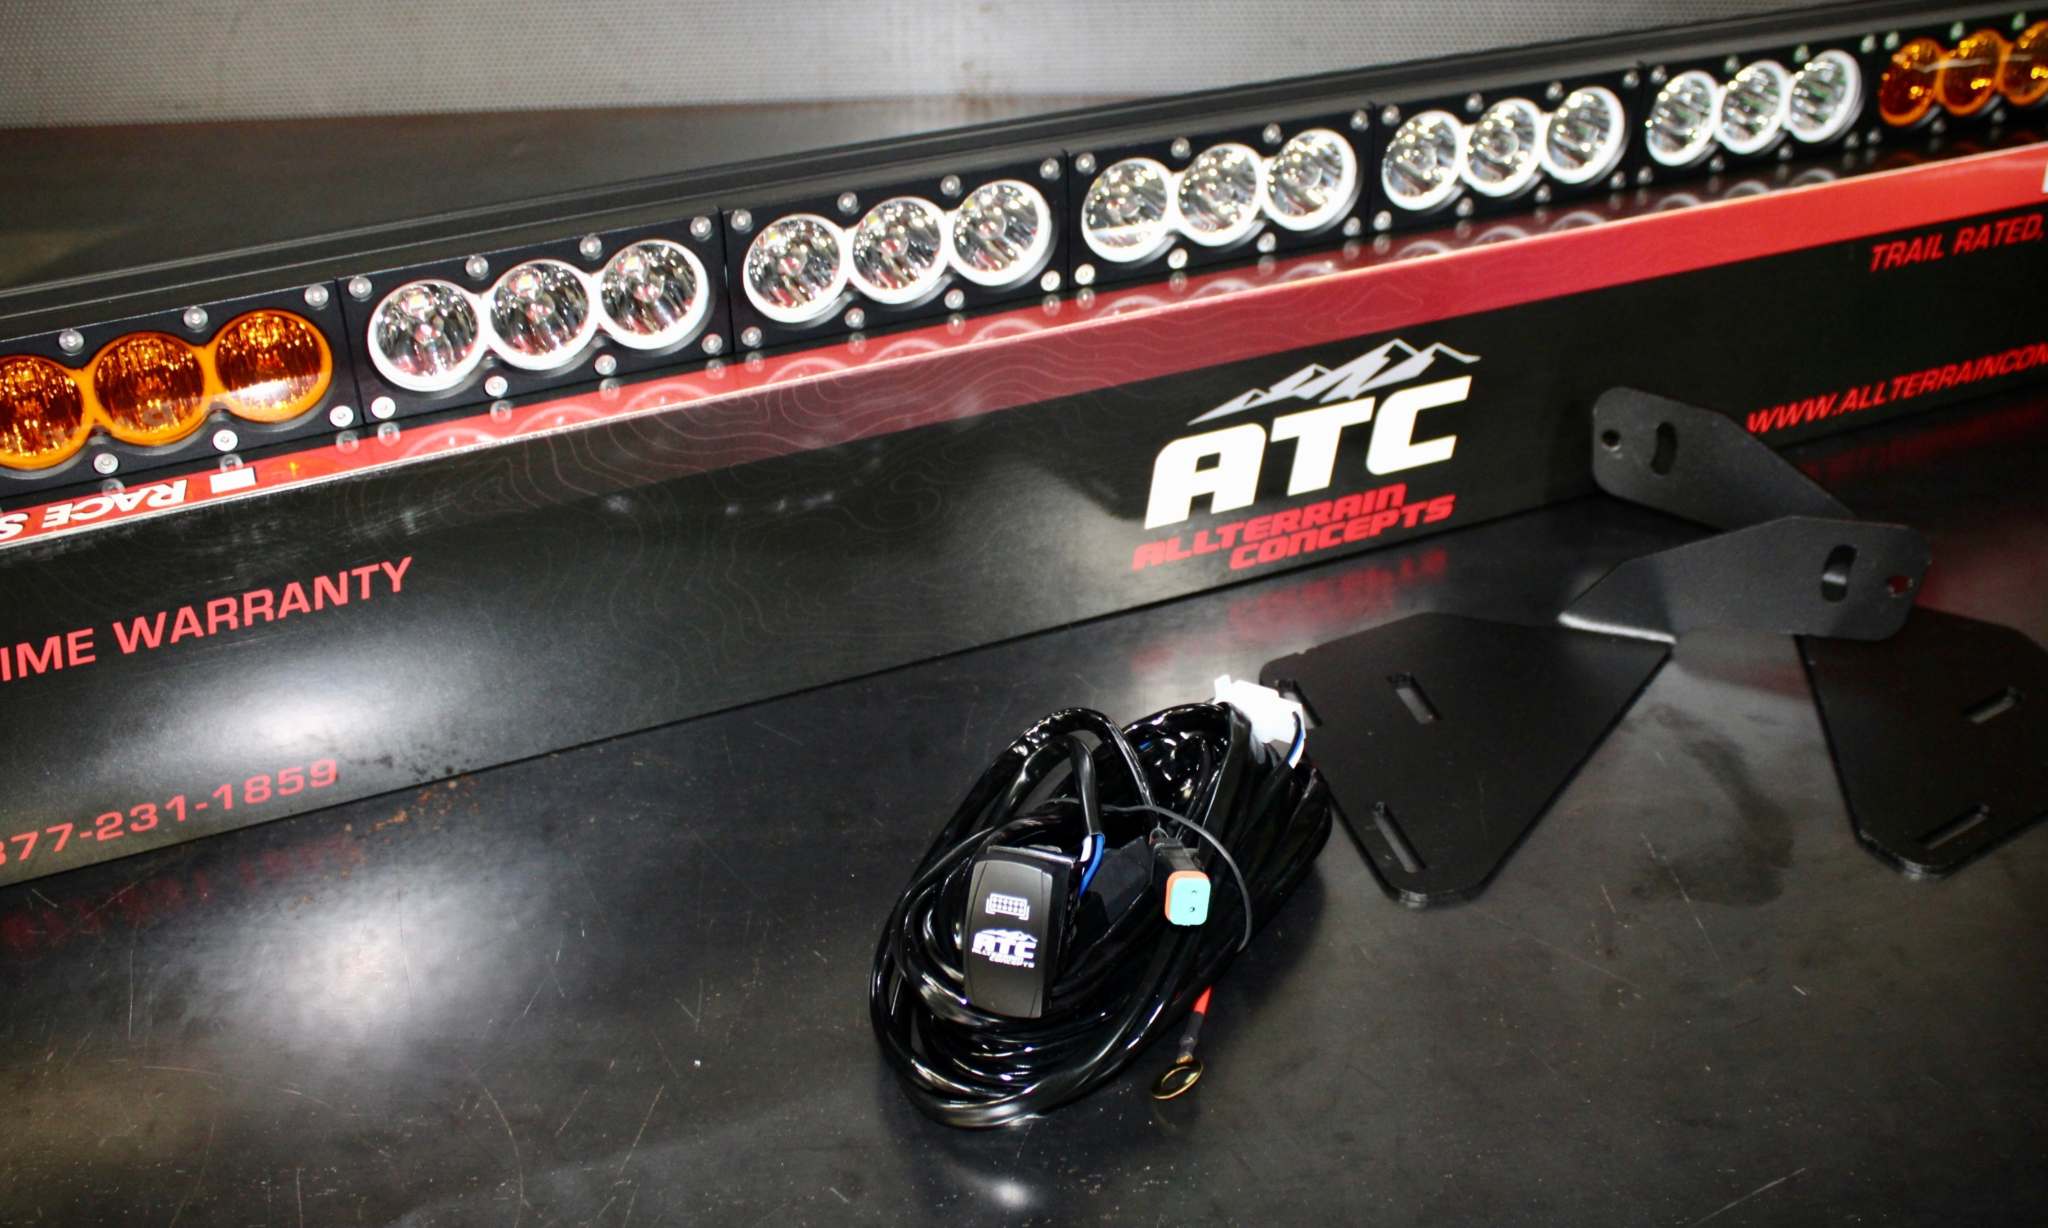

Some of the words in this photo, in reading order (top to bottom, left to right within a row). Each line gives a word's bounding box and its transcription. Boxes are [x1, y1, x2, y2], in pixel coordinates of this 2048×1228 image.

[1870, 232, 1945, 272] TRAIL
[1144, 375, 1472, 530] ATC
[41, 478, 187, 529] RACE
[1132, 482, 1406, 571] ALLTERRAIN
[1229, 494, 1456, 570] CONCEPTS
[111, 556, 413, 656] WARRANTY
[972, 930, 1037, 959] ATC
